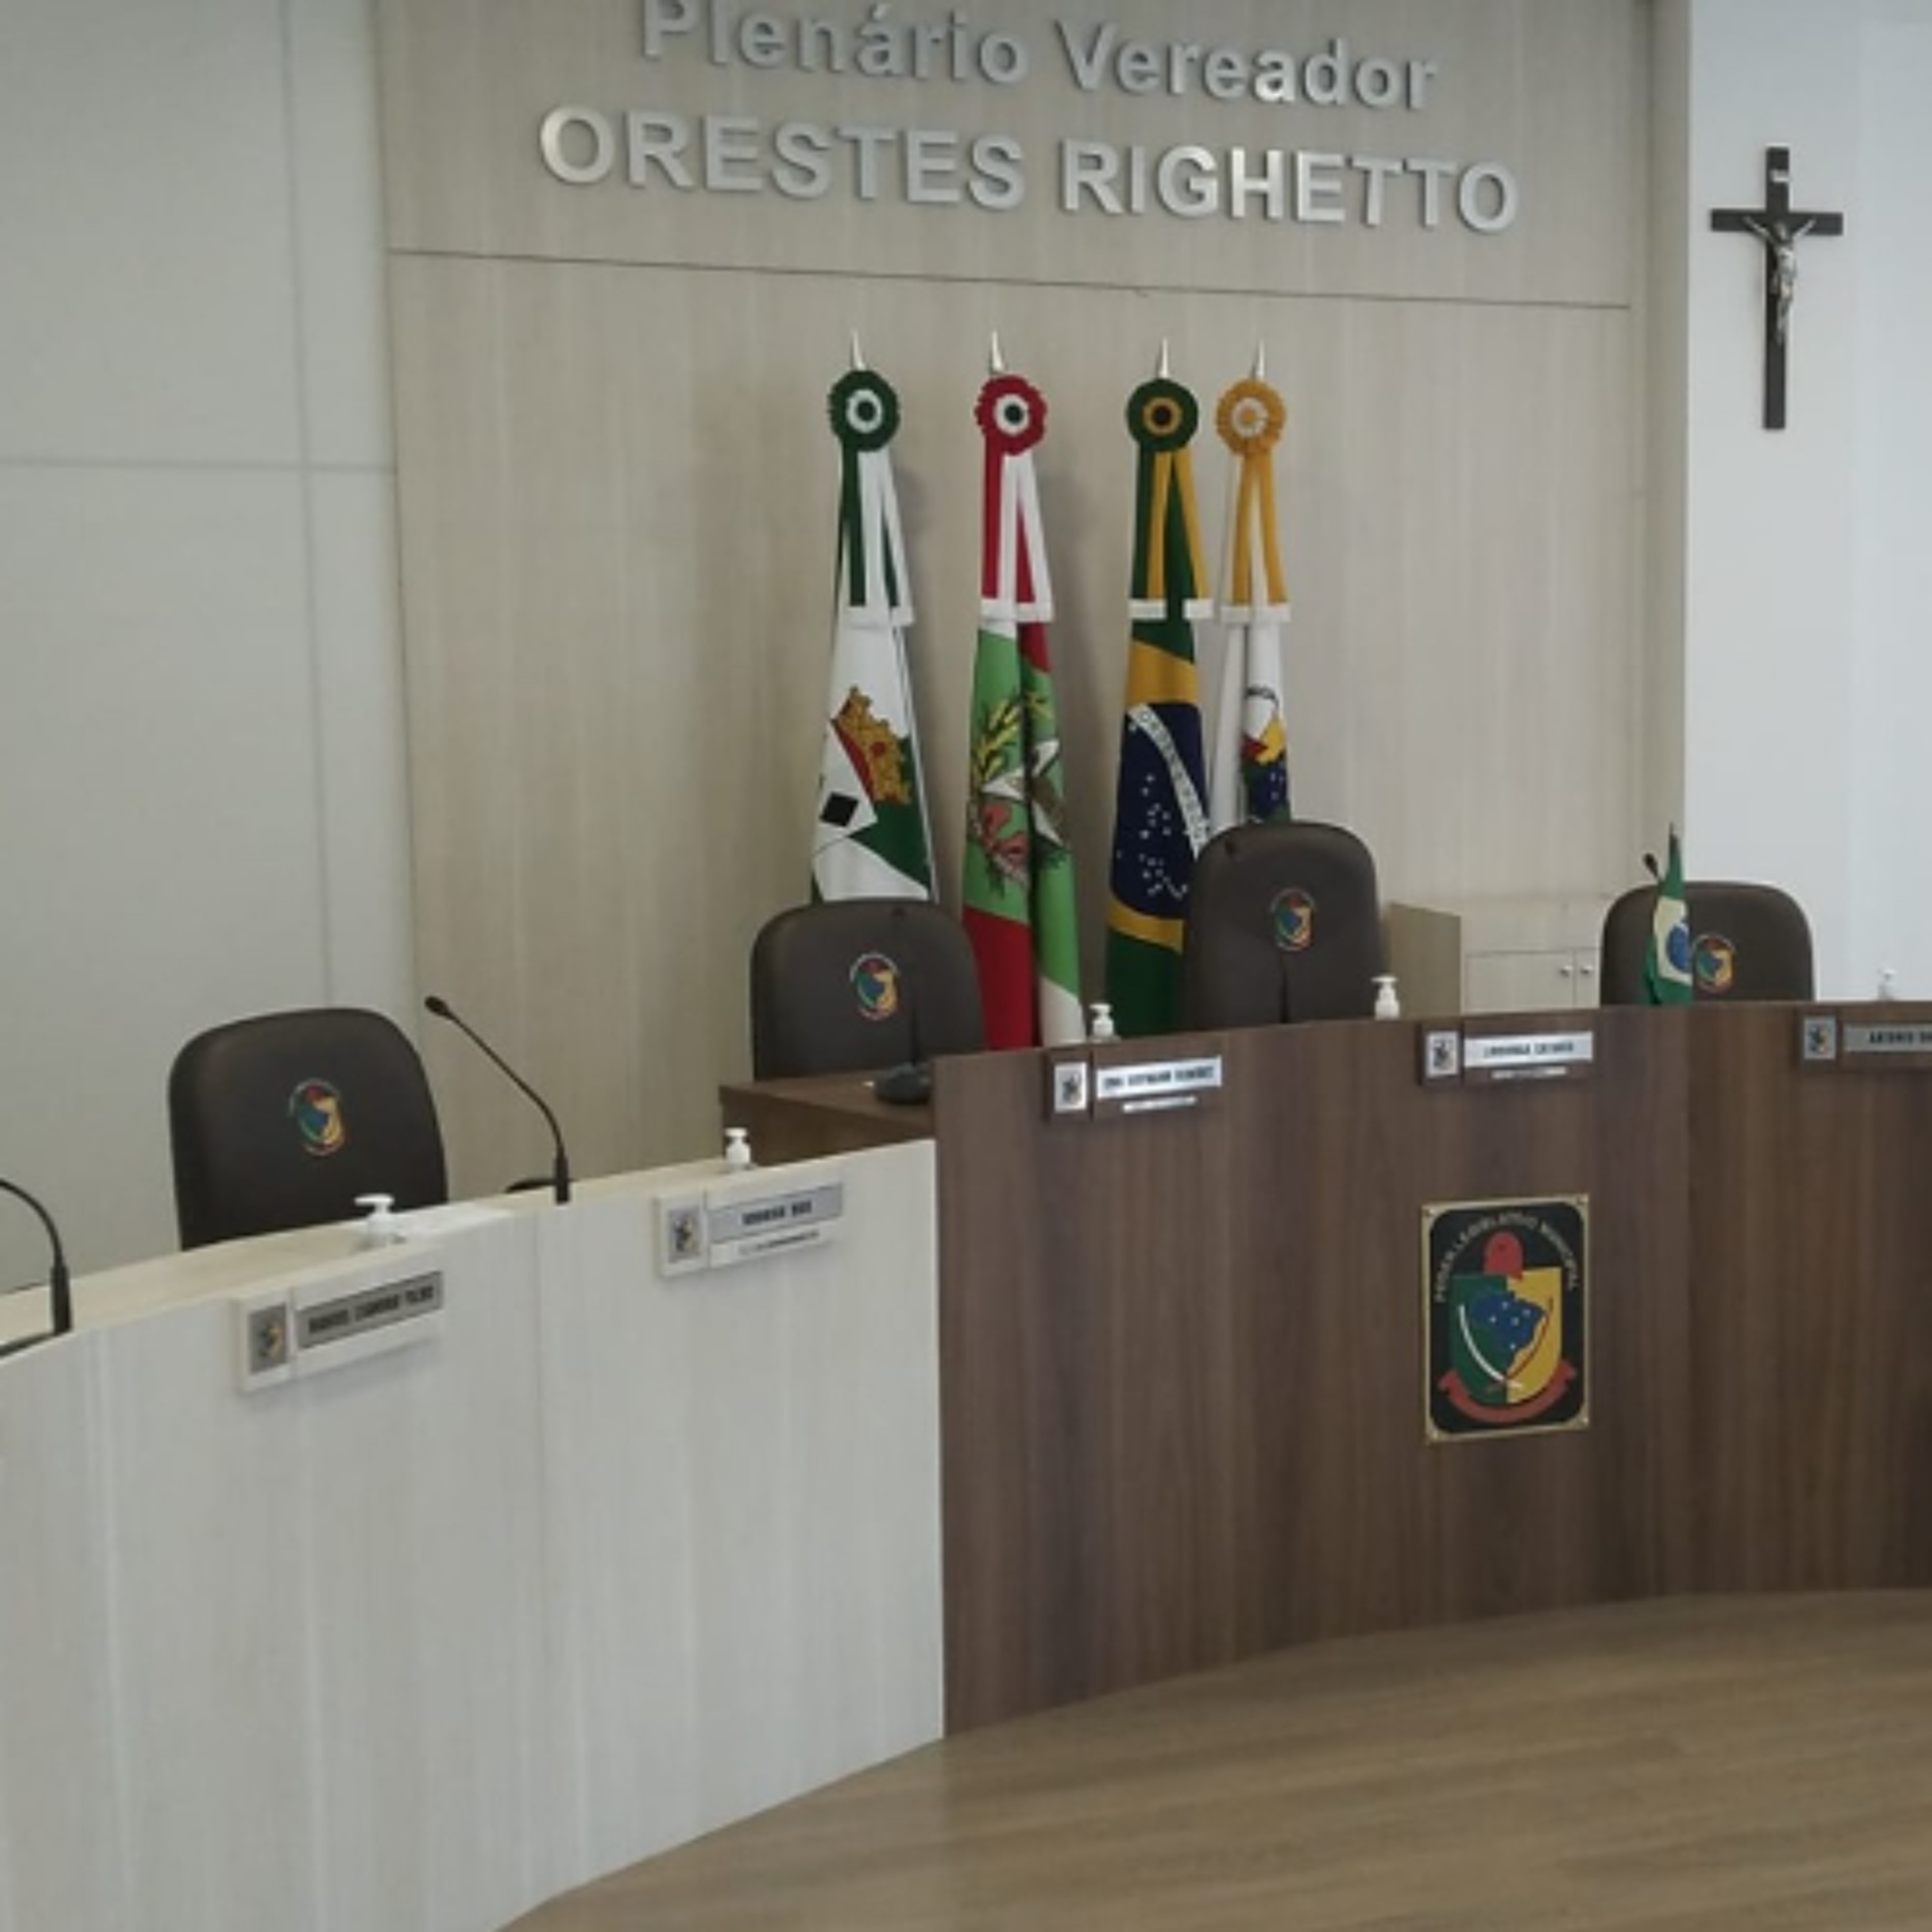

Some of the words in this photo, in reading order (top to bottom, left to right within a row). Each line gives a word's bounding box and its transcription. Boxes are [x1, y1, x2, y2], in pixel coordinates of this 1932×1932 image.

[643, 0, 1030, 85] Plenário
[1055, 20, 1439, 109] Vereador
[540, 106, 1025, 211] ORESTES
[1060, 138, 1518, 232] RIGHETTO
